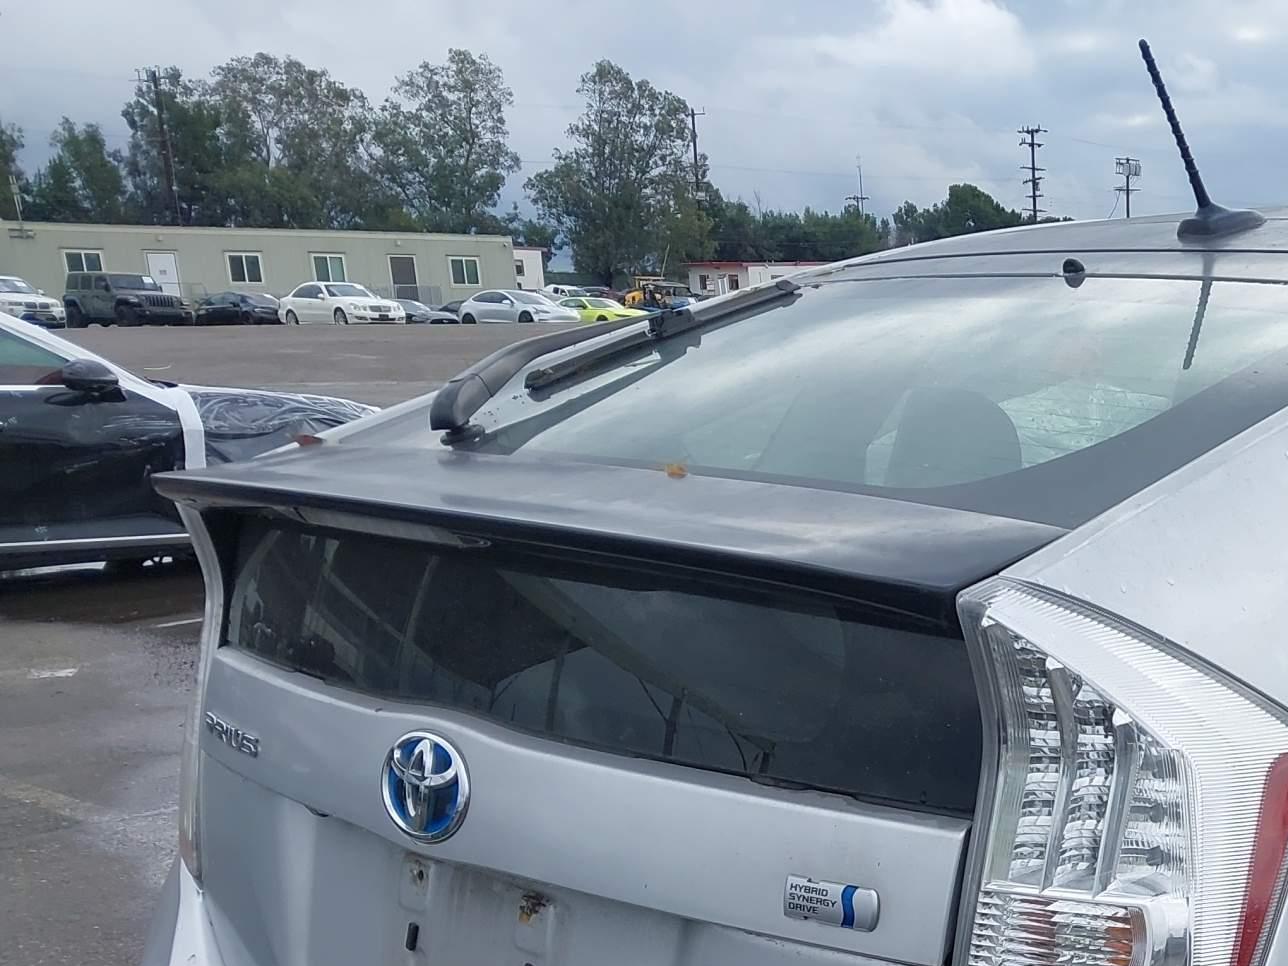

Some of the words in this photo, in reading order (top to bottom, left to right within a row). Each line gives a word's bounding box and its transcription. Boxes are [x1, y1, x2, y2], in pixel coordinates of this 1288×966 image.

[206, 711, 260, 758] PRIUS
[789, 883, 828, 897] HYBRID
[788, 893, 837, 908] SYNERGY
[788, 902, 819, 914] DRIVE
